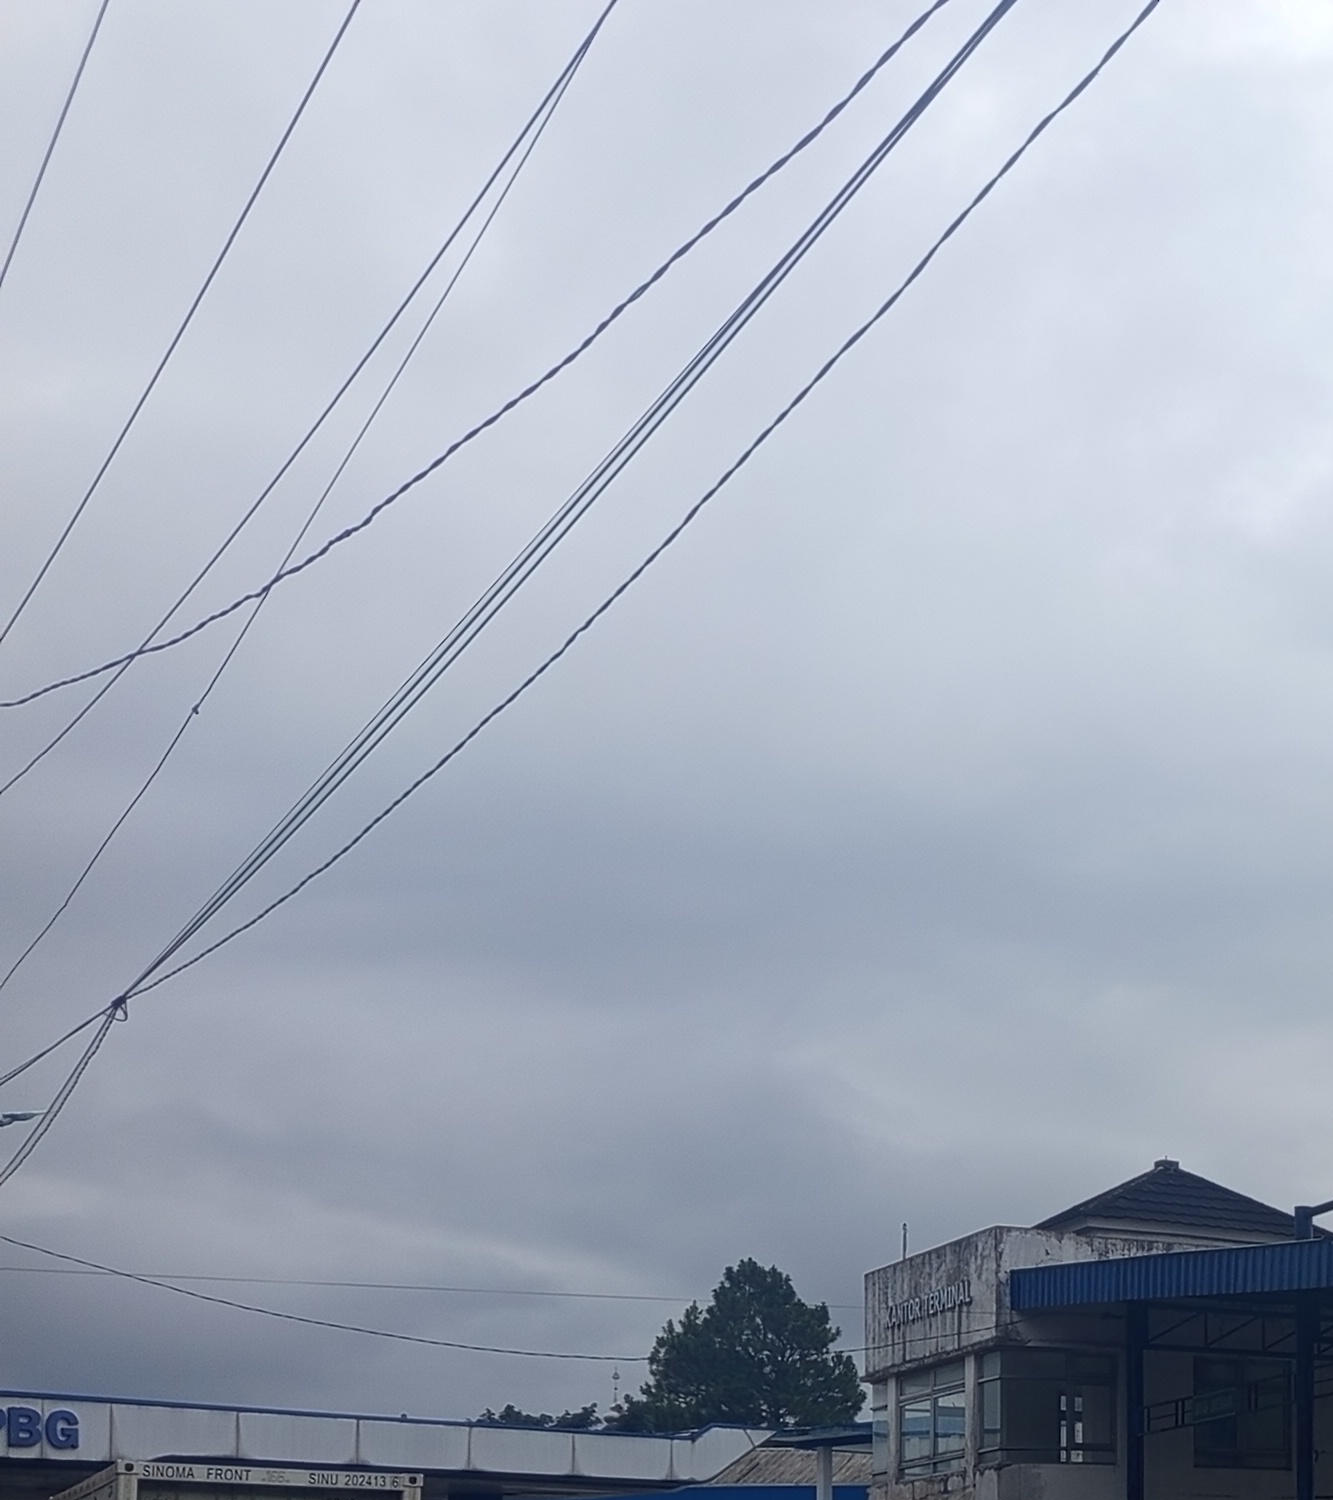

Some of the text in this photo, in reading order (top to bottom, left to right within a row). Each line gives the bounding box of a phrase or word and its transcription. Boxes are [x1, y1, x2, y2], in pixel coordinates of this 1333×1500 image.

[924, 1280, 972, 1316] TERMINAL
[142, 1465, 252, 1481] SINOMA FRONT
[308, 1473, 339, 1486] SINU
[344, 1474, 387, 1488] 202413
